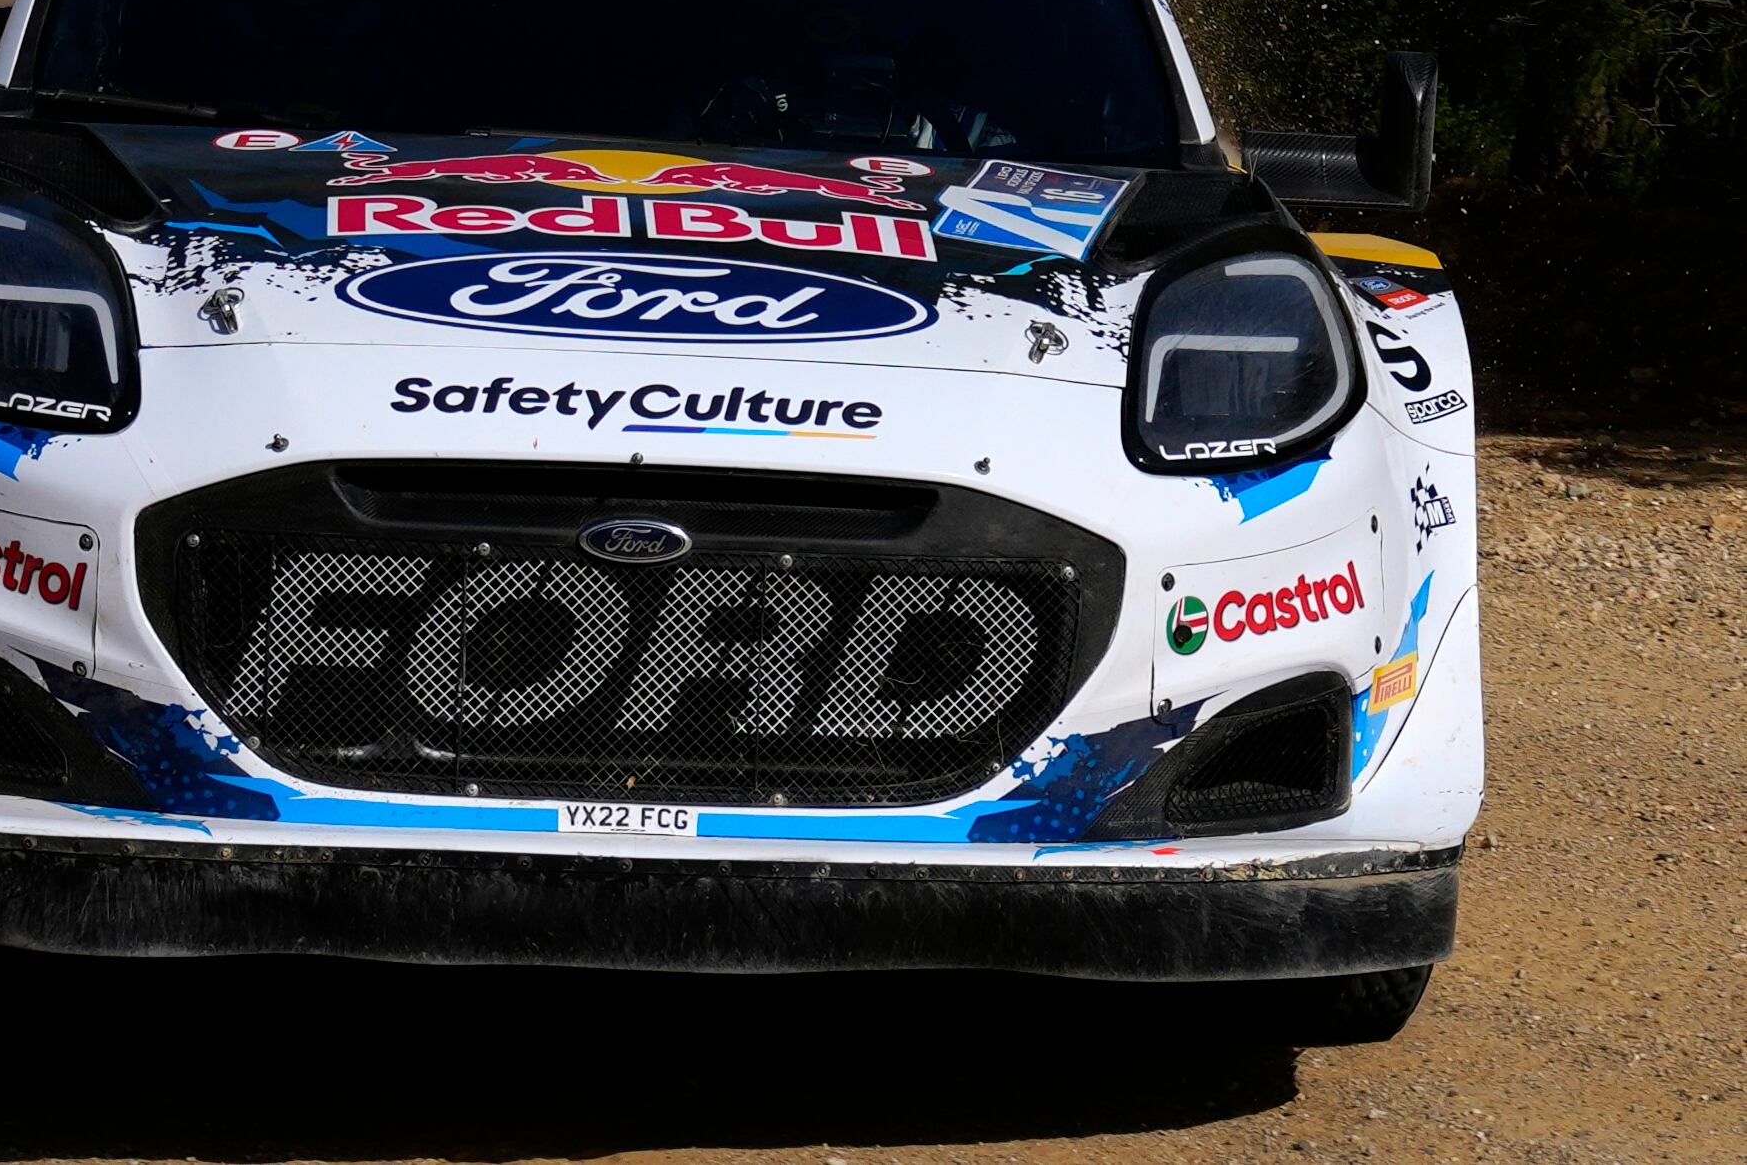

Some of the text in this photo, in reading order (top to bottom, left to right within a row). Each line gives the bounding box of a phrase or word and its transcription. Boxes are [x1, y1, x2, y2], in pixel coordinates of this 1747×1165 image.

[330, 196, 934, 260] Red Bull
[449, 258, 827, 330] Ford
[390, 376, 883, 431] SafetyCulture
[1407, 392, 1461, 423] sparco
[1158, 438, 1277, 461] LAZER
[604, 527, 667, 553] Ford
[1212, 560, 1365, 643] Castrol
[222, 553, 1040, 740] FORD
[1374, 662, 1413, 704] PIRELLI
[566, 805, 689, 830] YX22 FCG
